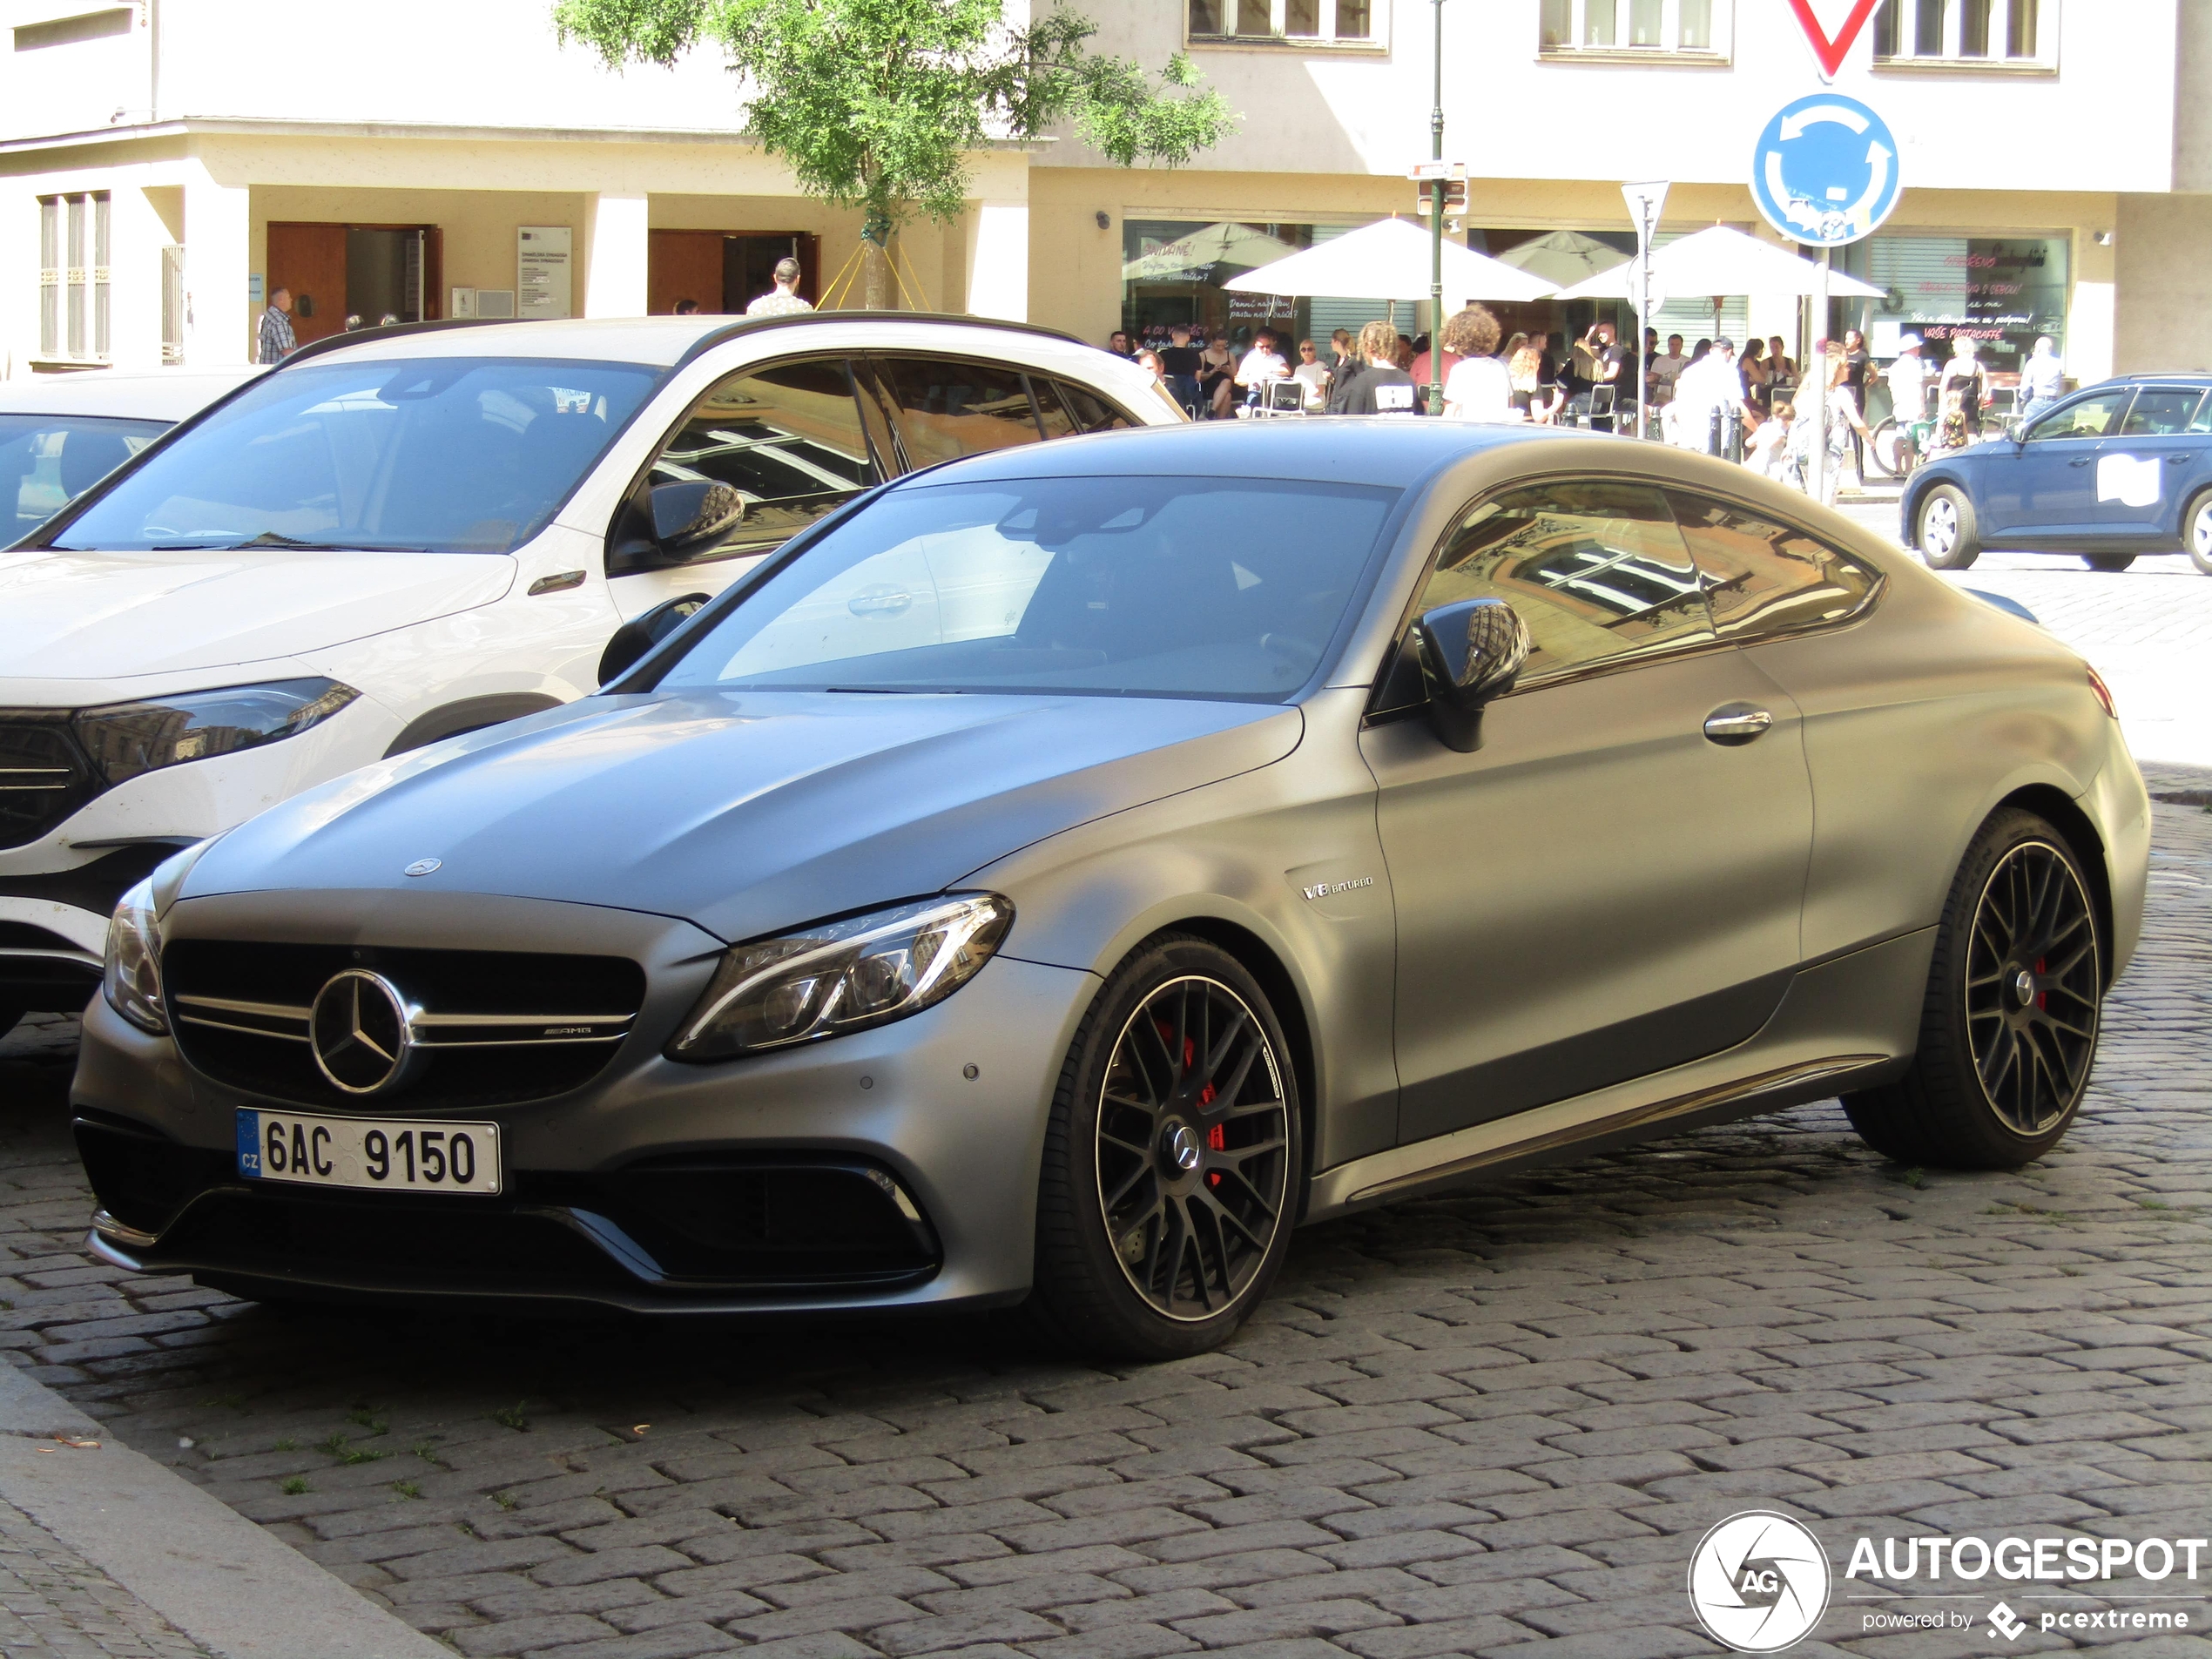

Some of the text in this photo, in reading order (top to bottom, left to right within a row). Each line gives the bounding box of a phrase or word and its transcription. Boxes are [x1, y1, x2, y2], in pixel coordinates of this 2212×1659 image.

[1143, 240, 1196, 257] SNÍDANĚ!
[1990, 283, 2023, 295] SEBOU!
[1911, 312, 1925, 323] Vás
[1143, 325, 1150, 335] A
[1152, 326, 1165, 335] CO
[1924, 326, 2005, 341] VAŠE PASTACAFFÉ
[1303, 876, 1373, 900] V8 BITURBO
[241, 1120, 476, 1184] CZ 6AC 9150
